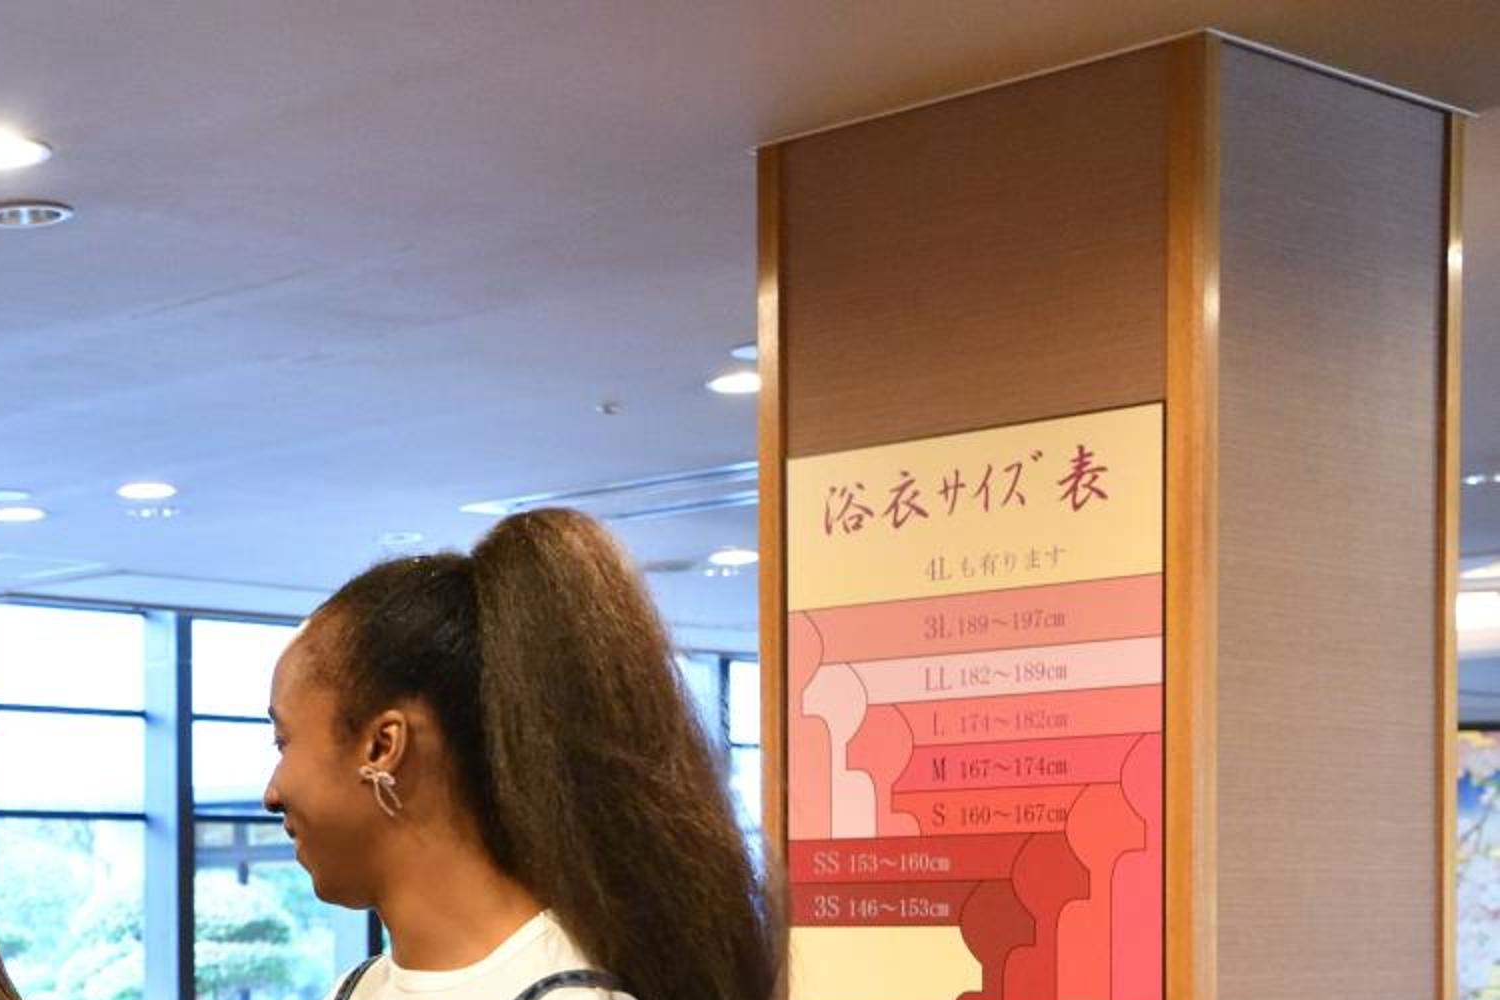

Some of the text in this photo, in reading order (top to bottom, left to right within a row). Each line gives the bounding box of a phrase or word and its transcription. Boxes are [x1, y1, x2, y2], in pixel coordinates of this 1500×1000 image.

[823, 443, 1109, 537] 浴衣サイズ表
[923, 613, 952, 640] 3L
[924, 665, 953, 692] LL
[932, 710, 945, 737] L
[932, 756, 946, 782] M
[932, 802, 946, 827] S
[813, 851, 840, 876] SS
[813, 895, 840, 919] 3S
